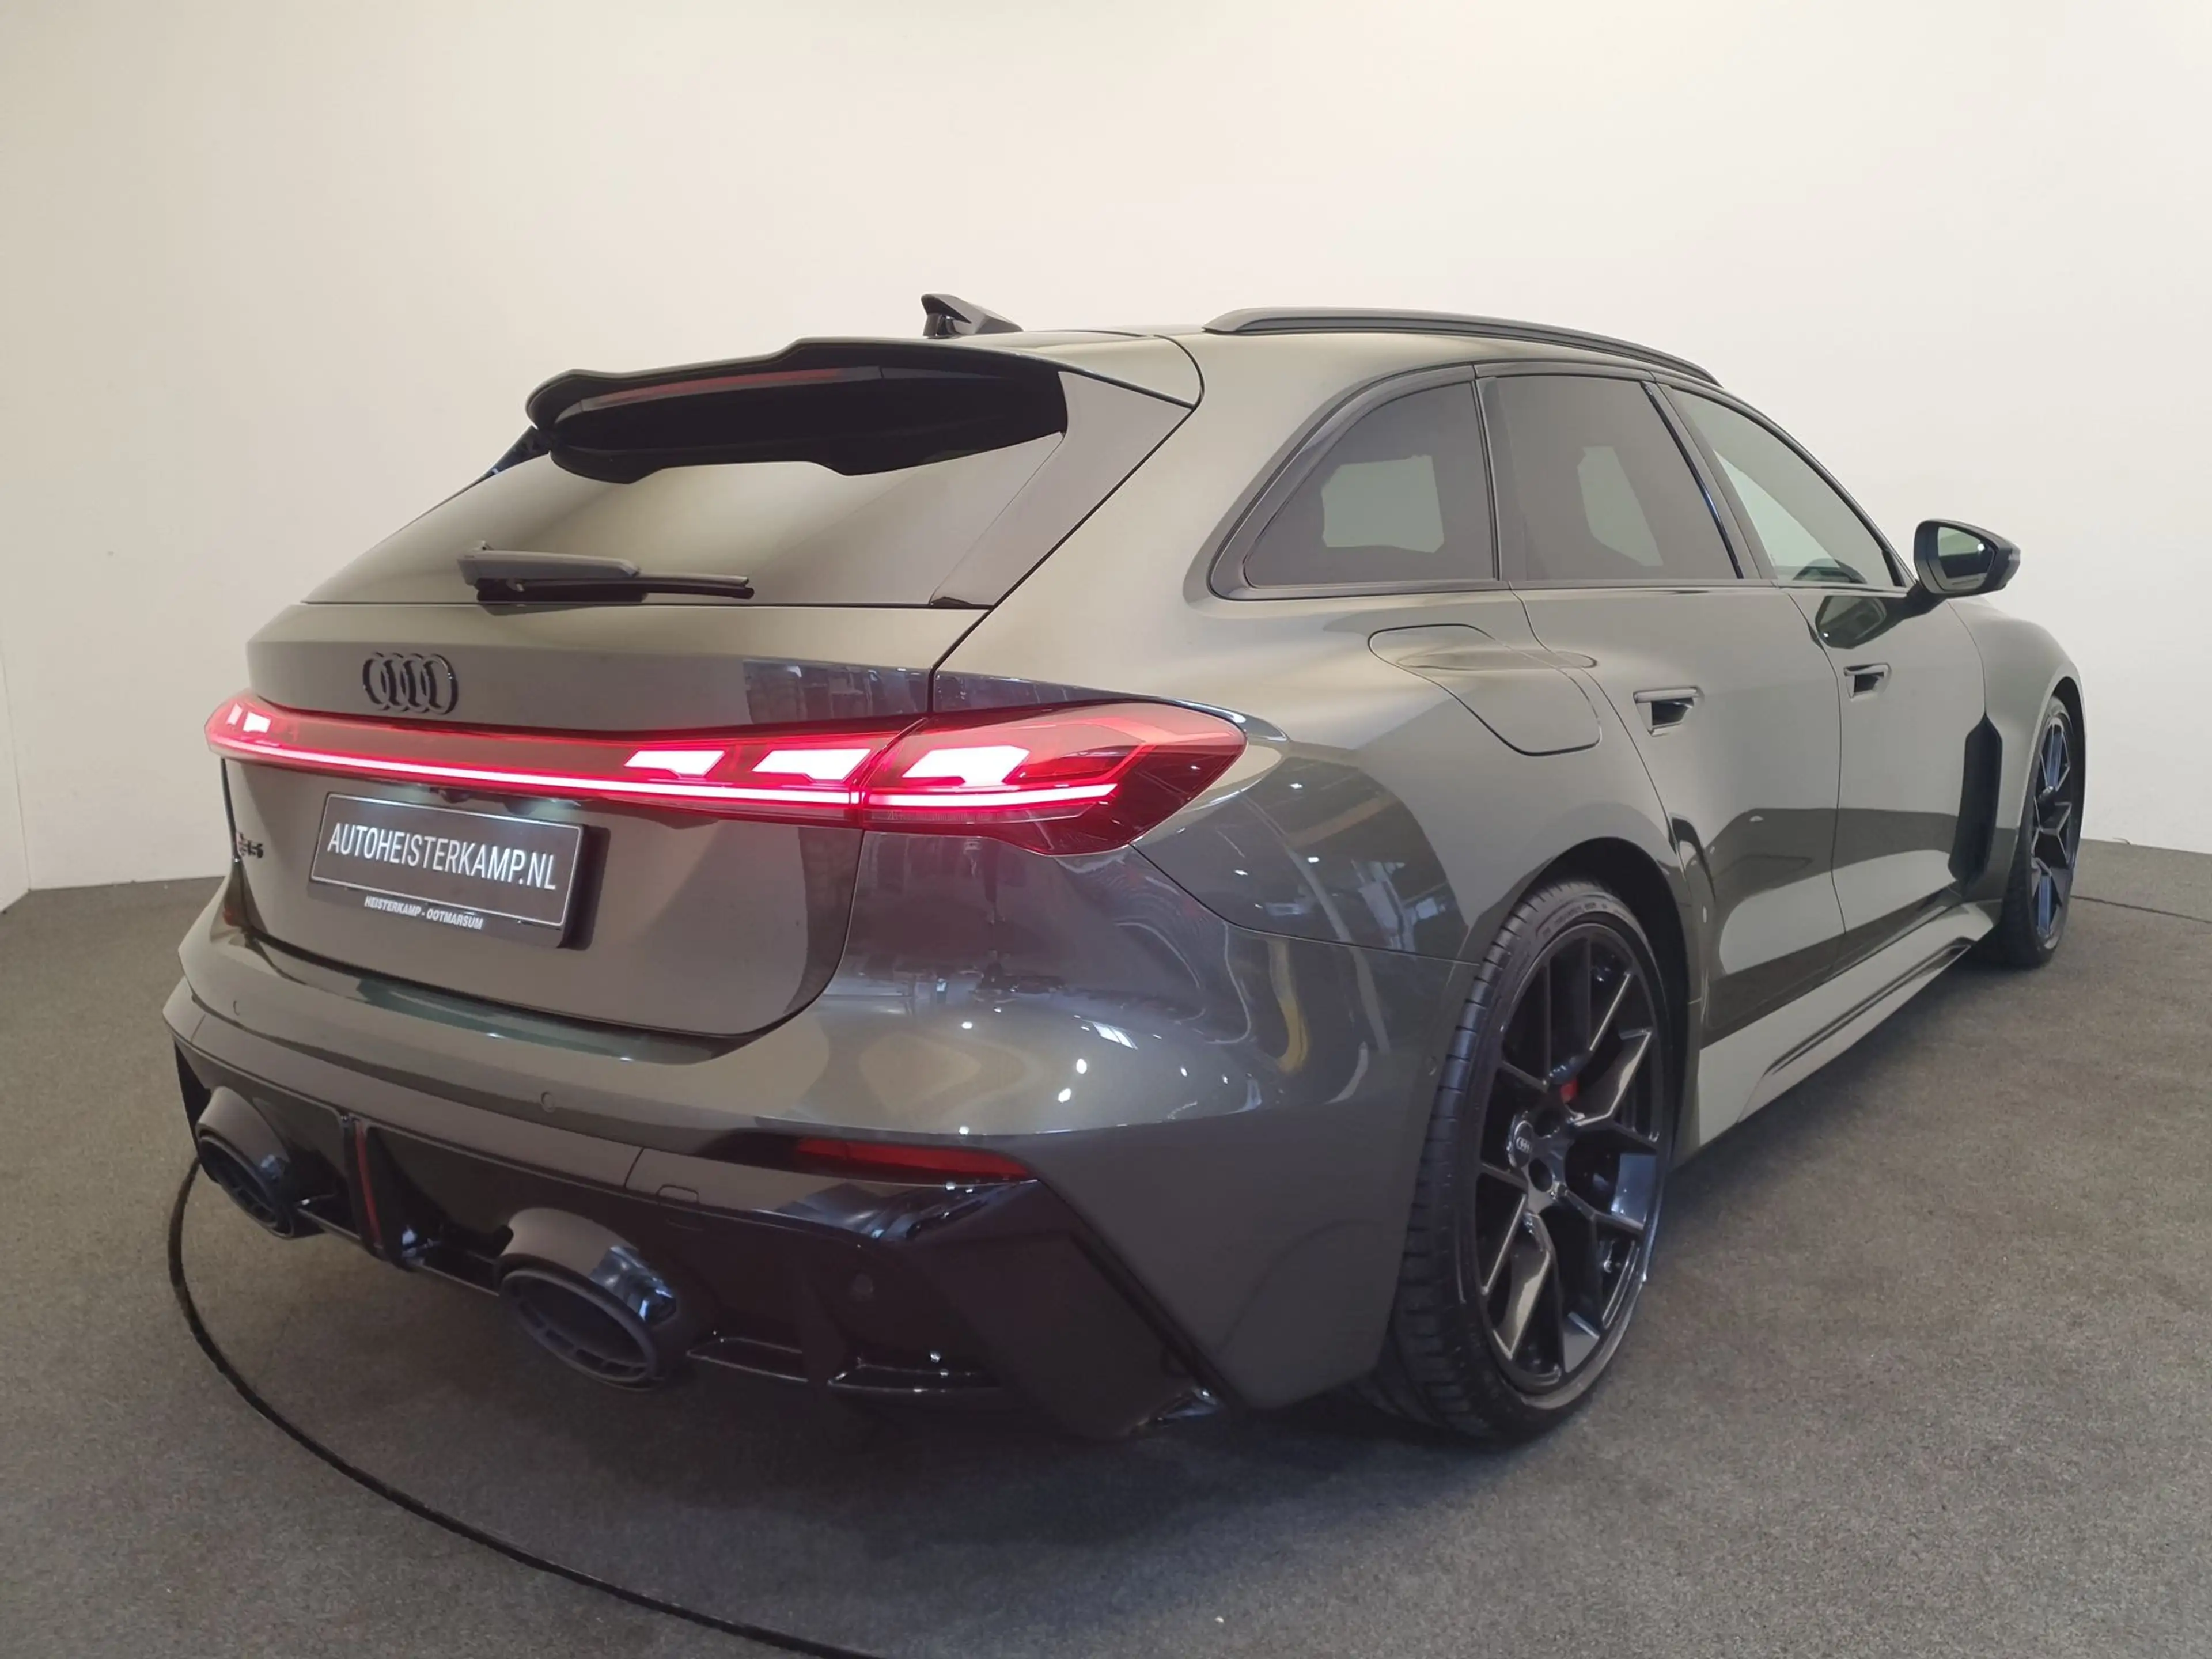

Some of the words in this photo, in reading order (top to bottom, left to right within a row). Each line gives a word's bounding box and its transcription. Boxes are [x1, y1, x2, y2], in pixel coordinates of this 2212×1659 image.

[327, 823, 556, 890] AUTOHEISTERKAMP.NL
[364, 895, 422, 917] HEISTERKAMP
[426, 908, 484, 930] OOTMARSUM
